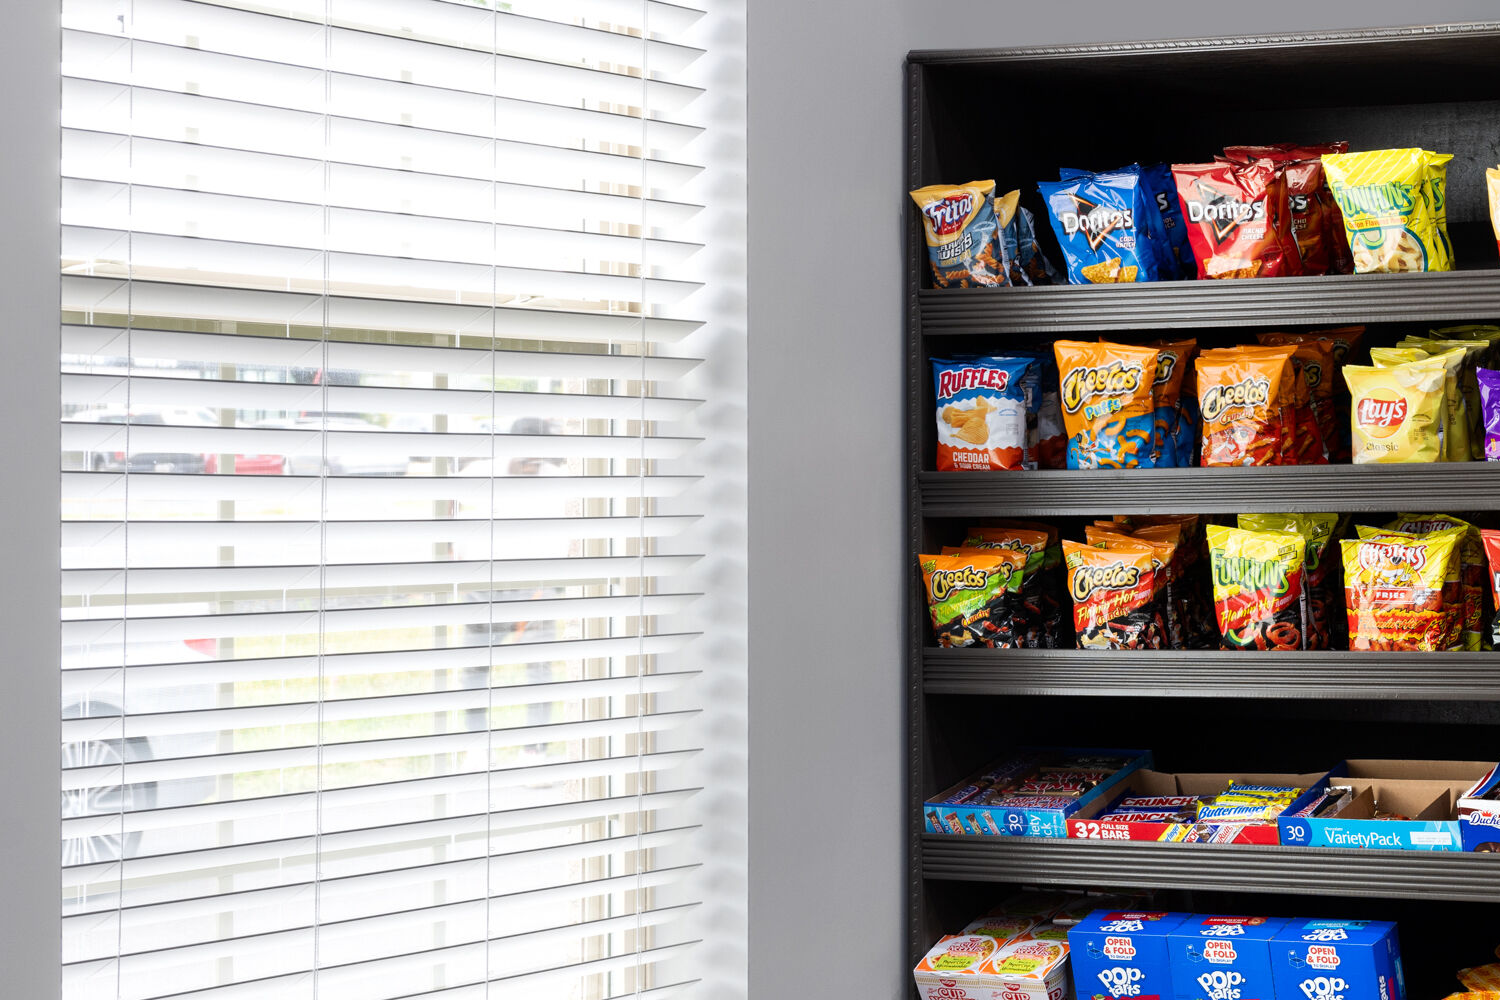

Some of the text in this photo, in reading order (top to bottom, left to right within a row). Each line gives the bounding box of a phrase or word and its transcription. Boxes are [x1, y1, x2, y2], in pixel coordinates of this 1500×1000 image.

[922, 194, 973, 234] Fritos
[1187, 200, 1264, 222] Doritos
[1063, 208, 1133, 234] Doritos
[938, 367, 1009, 399] RUFFLES
[1062, 358, 1144, 415] Cheetos
[1202, 378, 1270, 422] Cheetos
[1084, 398, 1122, 421] Puffs
[1357, 396, 1405, 427] Lay's
[1366, 442, 1399, 453] Classic
[952, 451, 990, 464] CHEDDAR
[1211, 547, 1290, 598] FUNYUNS
[932, 565, 987, 601] Cheetos
[1074, 561, 1139, 602] Cheetos
[1122, 797, 1194, 808] CRUNCH
[1100, 812, 1172, 823] CRUNCH
[1198, 805, 1269, 820] Butterfinger
[1008, 814, 1023, 832] 30
[1074, 822, 1101, 838] 32
[1102, 830, 1130, 840] BARS
[1286, 826, 1305, 840] 30
[1106, 938, 1131, 946] OPEN
[1207, 941, 1232, 950] OPEN
[1113, 946, 1135, 955] FOLD
[1204, 950, 1236, 958] & FOLD
[1310, 946, 1334, 956] OPEN
[1307, 956, 1339, 964] & FOLD
[938, 988, 966, 999] CUP
[1108, 984, 1141, 998] tarts
